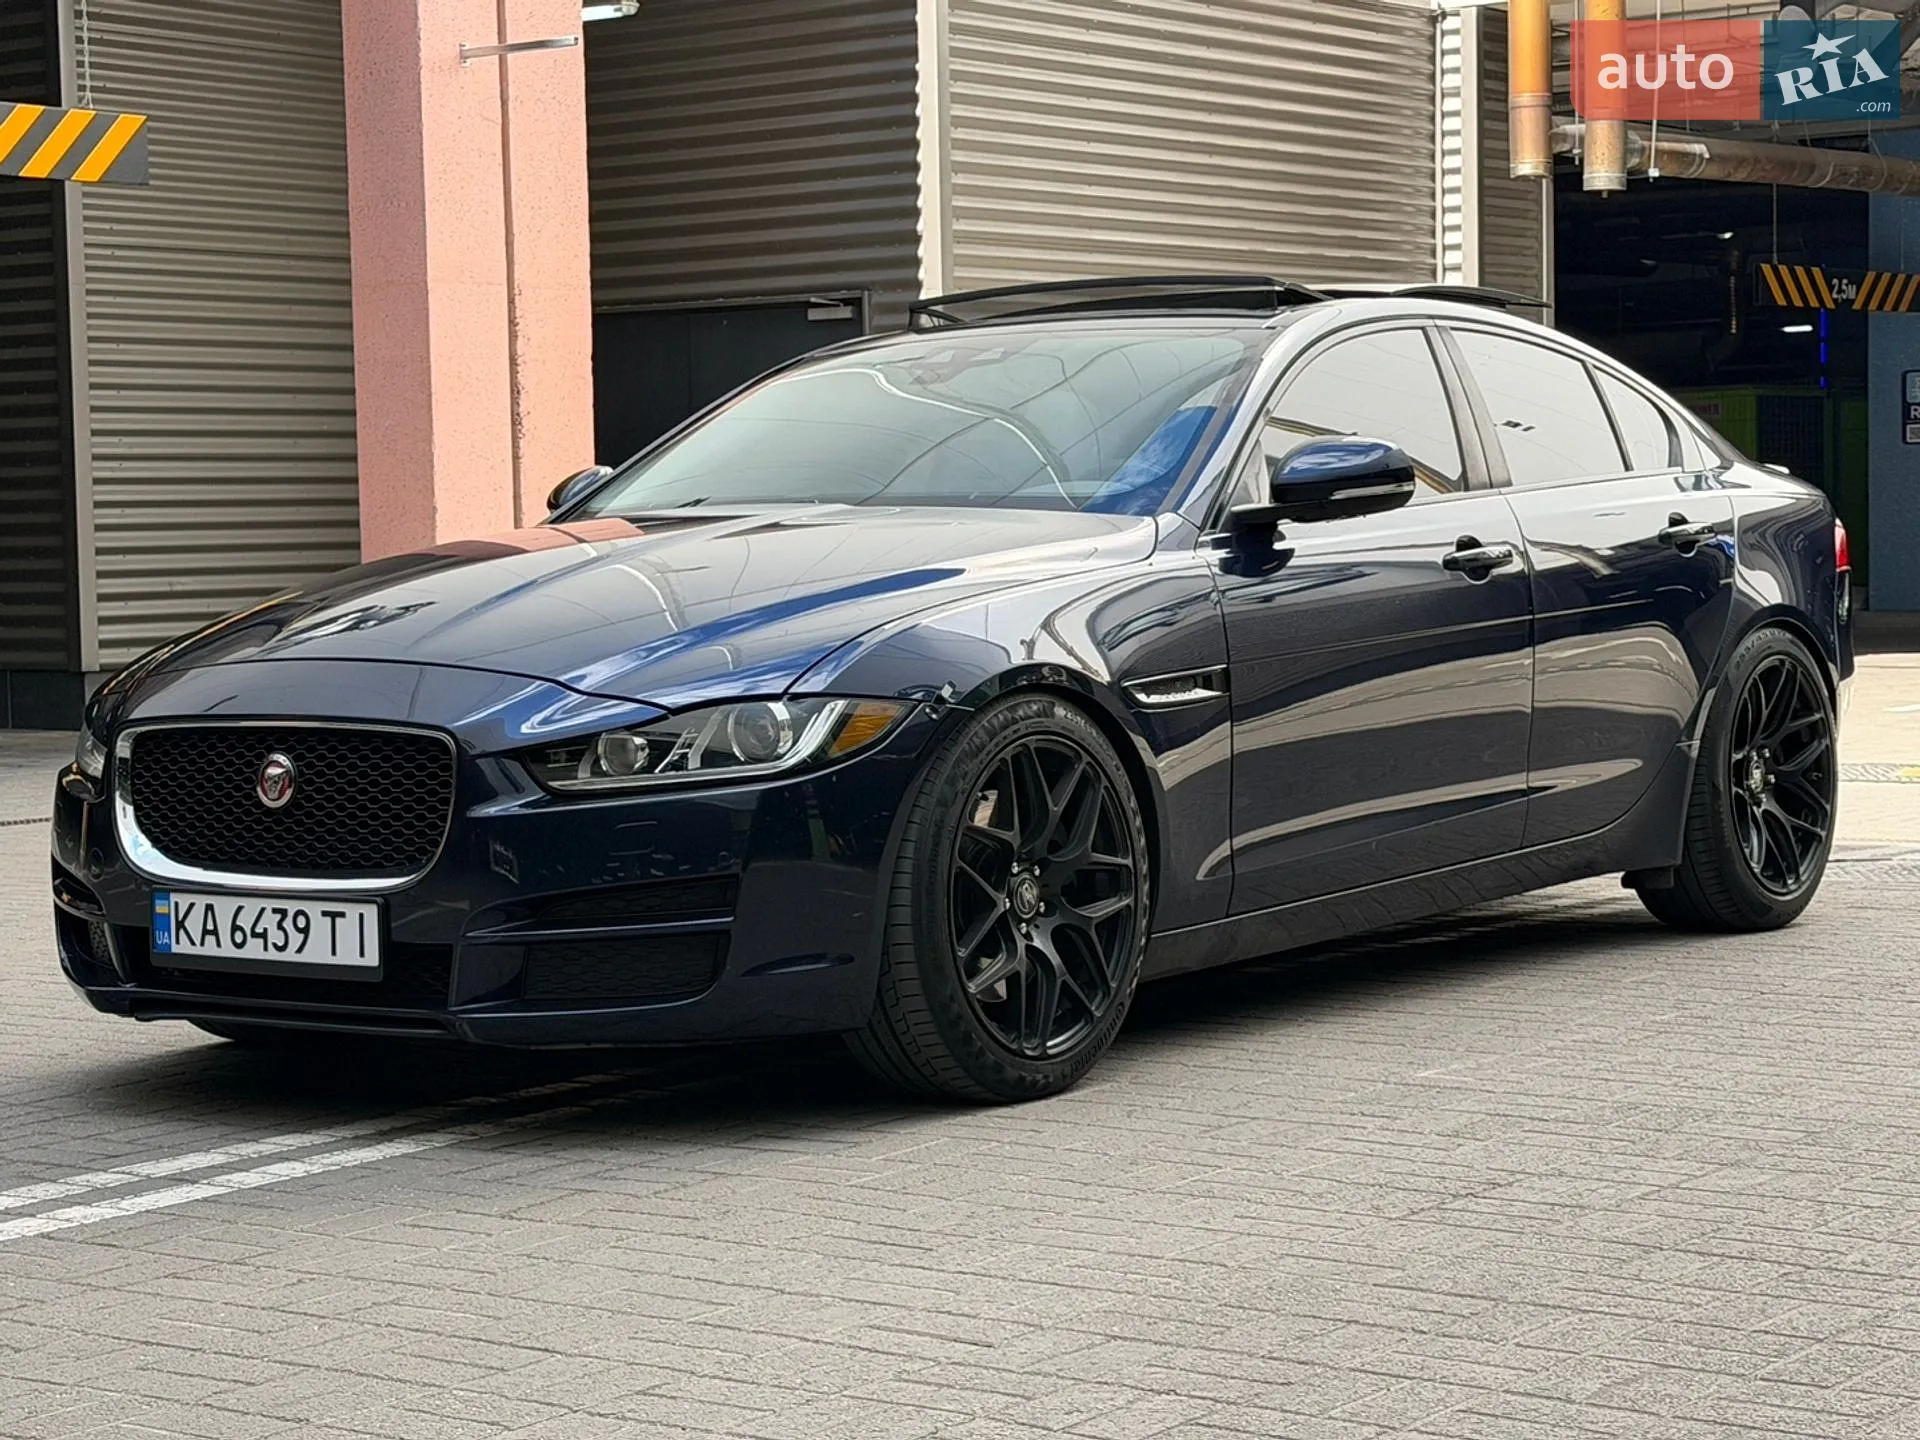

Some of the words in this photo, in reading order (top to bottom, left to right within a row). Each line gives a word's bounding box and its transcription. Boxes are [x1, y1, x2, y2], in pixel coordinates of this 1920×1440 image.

[155, 930, 170, 945] UA
[173, 900, 222, 949] KA
[230, 905, 311, 954] 6439
[320, 910, 366, 958] TI
